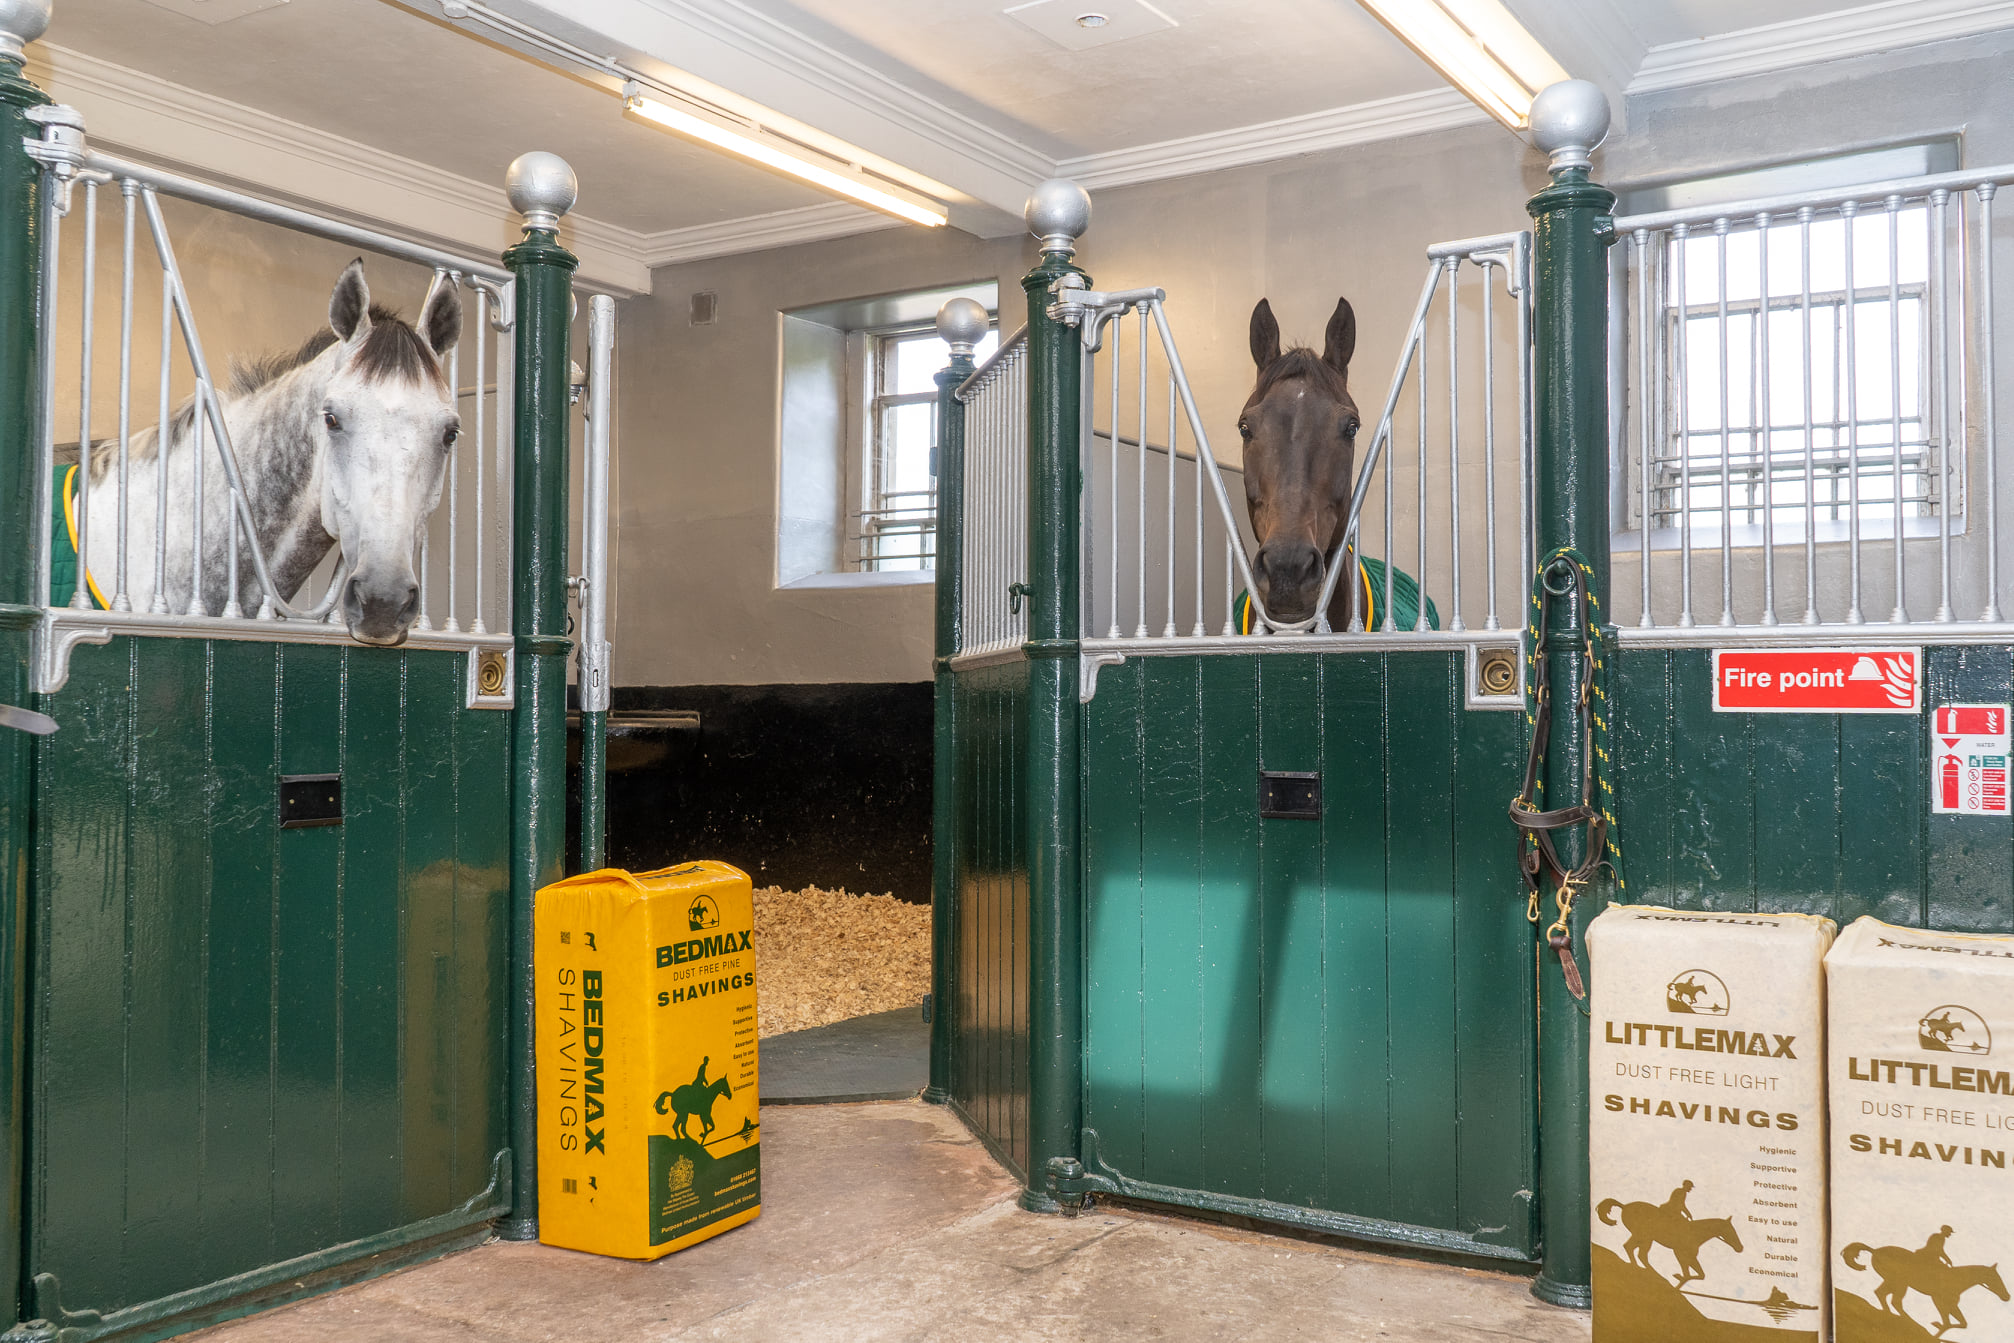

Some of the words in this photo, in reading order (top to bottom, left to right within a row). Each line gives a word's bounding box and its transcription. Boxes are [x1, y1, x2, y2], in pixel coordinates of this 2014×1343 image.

[1725, 668, 1771, 687] Fire
[1780, 668, 1845, 692] point
[656, 929, 753, 969] BEDMAX
[673, 967, 696, 981] DUST
[699, 963, 720, 976] FREE
[723, 958, 741, 971] PINE
[657, 972, 754, 1007] SHAVINGS
[1605, 1021, 1798, 1060] LITTLEMAX
[558, 968, 578, 1151] SHAVINGS
[582, 970, 605, 1156] BEDMAX
[1616, 1062, 1662, 1079] DUST
[1669, 1068, 1715, 1085] FREE
[1723, 1073, 1779, 1091] LIGHT
[1848, 1056, 2014, 1096] LITTLEM
[1604, 1094, 1799, 1131] SHAVINGS
[1862, 1100, 1915, 1119] DUST
[1923, 1107, 1976, 1127] FREE
[1759, 1145, 1797, 1156] Hygienic
[1849, 1133, 2014, 1169] SHAVIN
[1750, 1162, 1797, 1174] Supportive
[1753, 1180, 1798, 1192] Protective
[1752, 1198, 1798, 1209] Absorbent
[661, 1222, 683, 1233] Purpose
[683, 1216, 698, 1225] made
[1748, 1215, 1769, 1226] Easy
[1766, 1234, 1798, 1245] Natural
[1764, 1252, 1798, 1262] Durable
[1749, 1267, 1798, 1278] Economical
